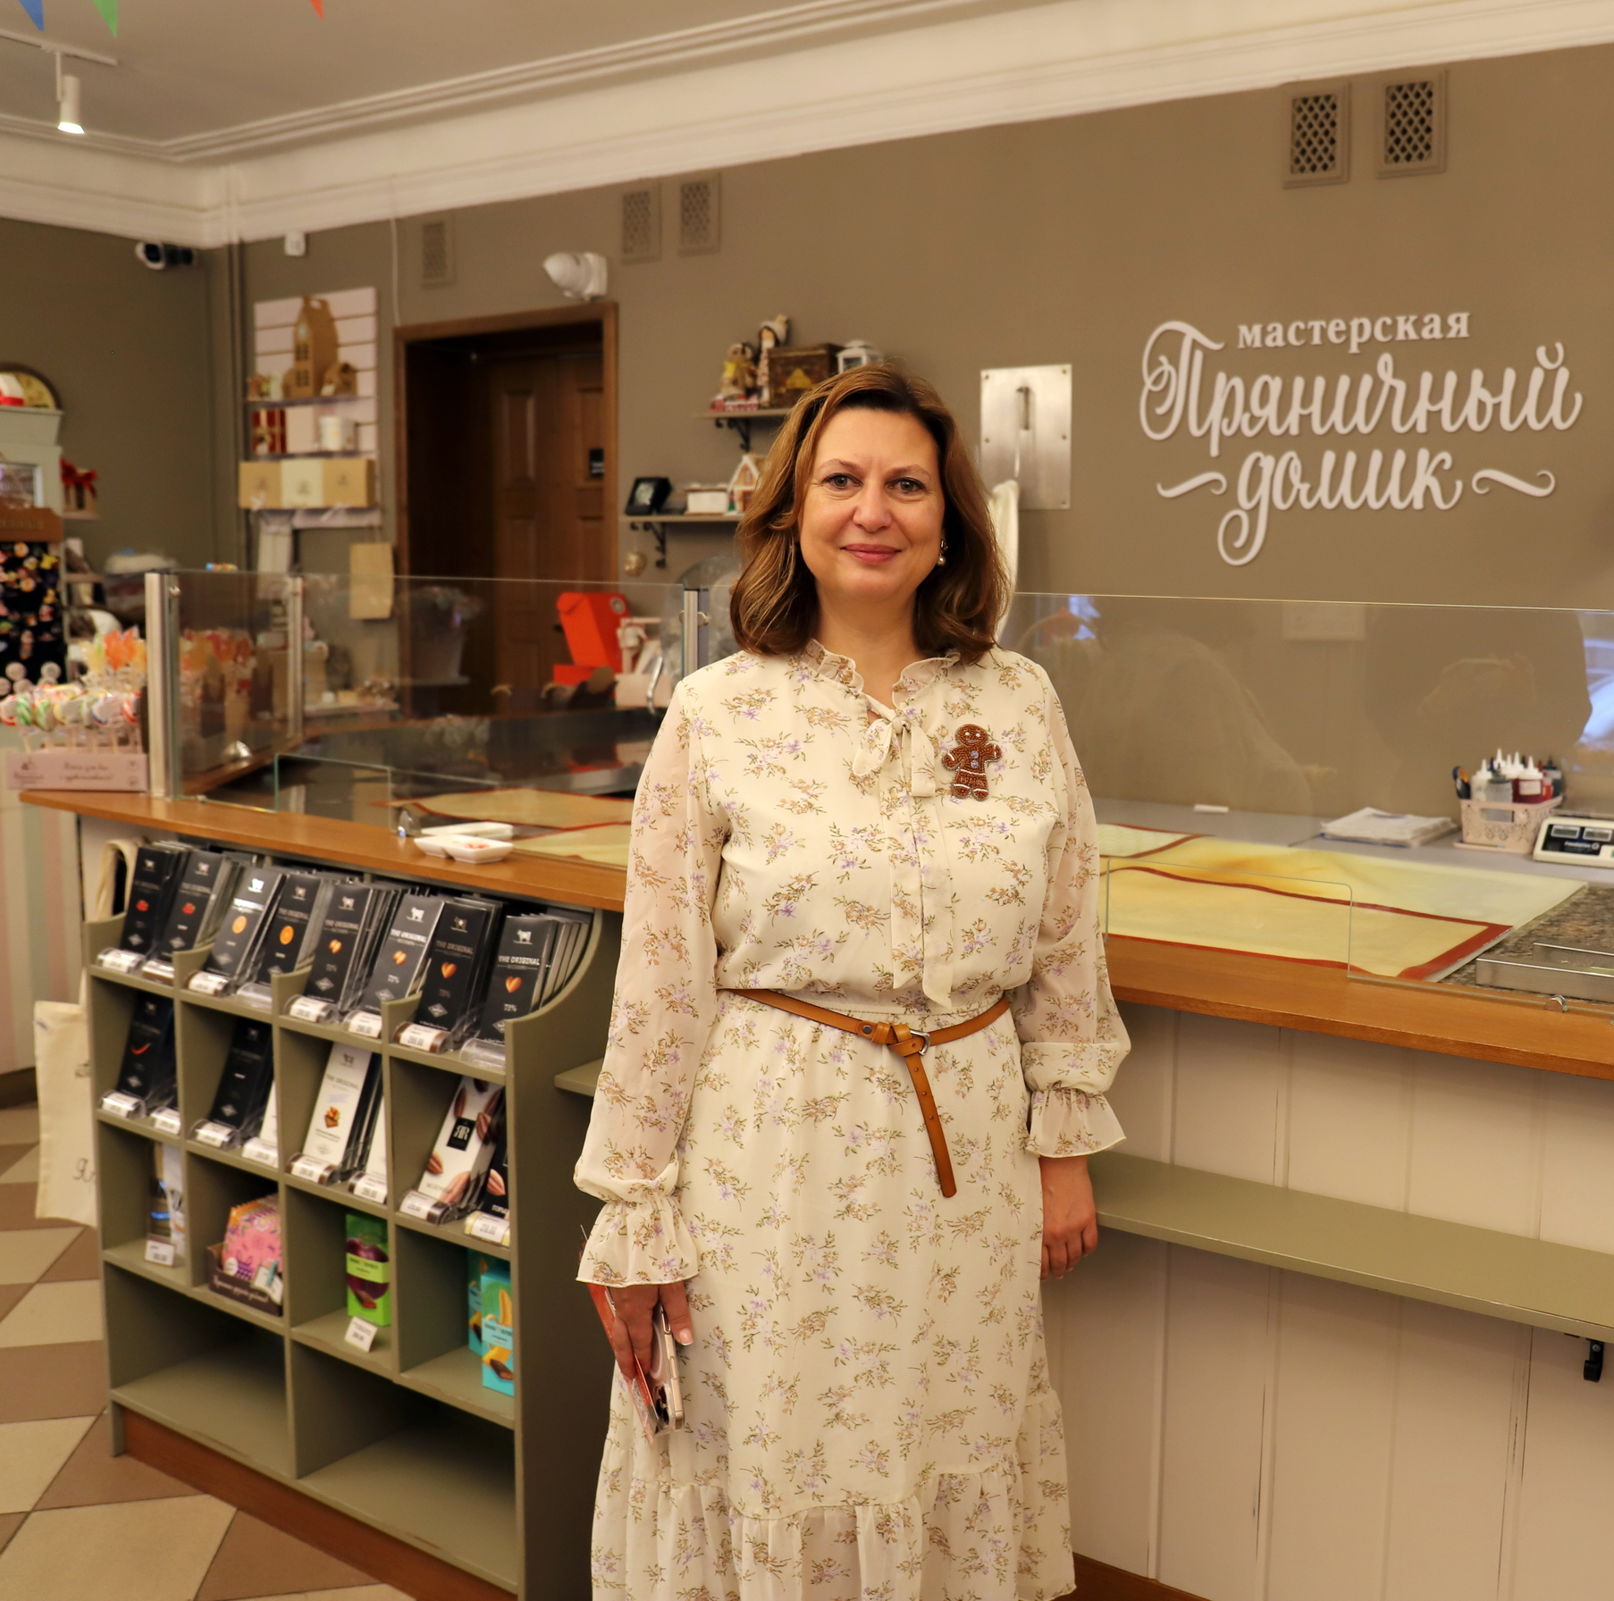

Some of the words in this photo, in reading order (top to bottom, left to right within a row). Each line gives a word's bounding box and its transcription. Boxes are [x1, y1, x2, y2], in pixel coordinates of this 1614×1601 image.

[1139, 320, 1583, 457] Пряничный
[1237, 312, 1471, 354] мастерская
[1217, 447, 1463, 566] домик
